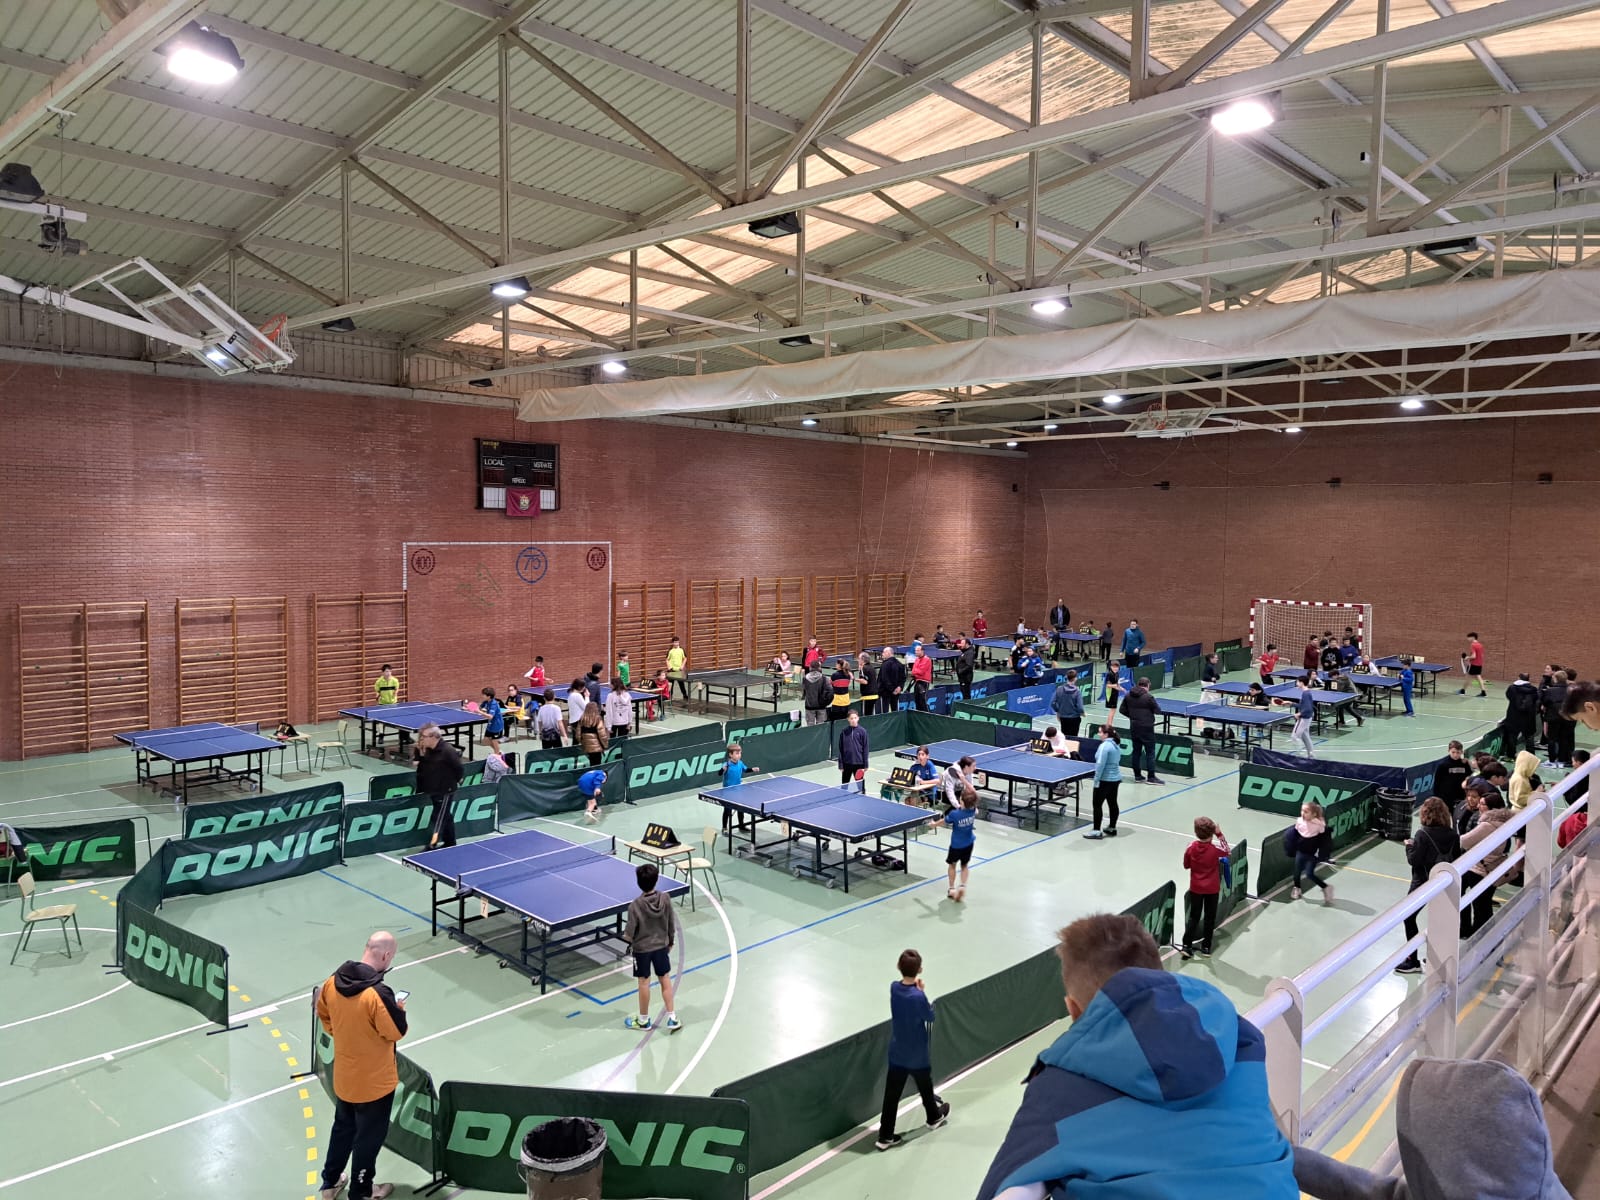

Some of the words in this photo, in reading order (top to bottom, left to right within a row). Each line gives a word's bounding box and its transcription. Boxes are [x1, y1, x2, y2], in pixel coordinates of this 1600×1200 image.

[484, 458, 504, 466] LOCAL
[629, 751, 726, 788] DONIC
[166, 824, 340, 885] DONIC
[125, 923, 226, 1000] DONIC
[446, 1110, 744, 1174] DNIC
